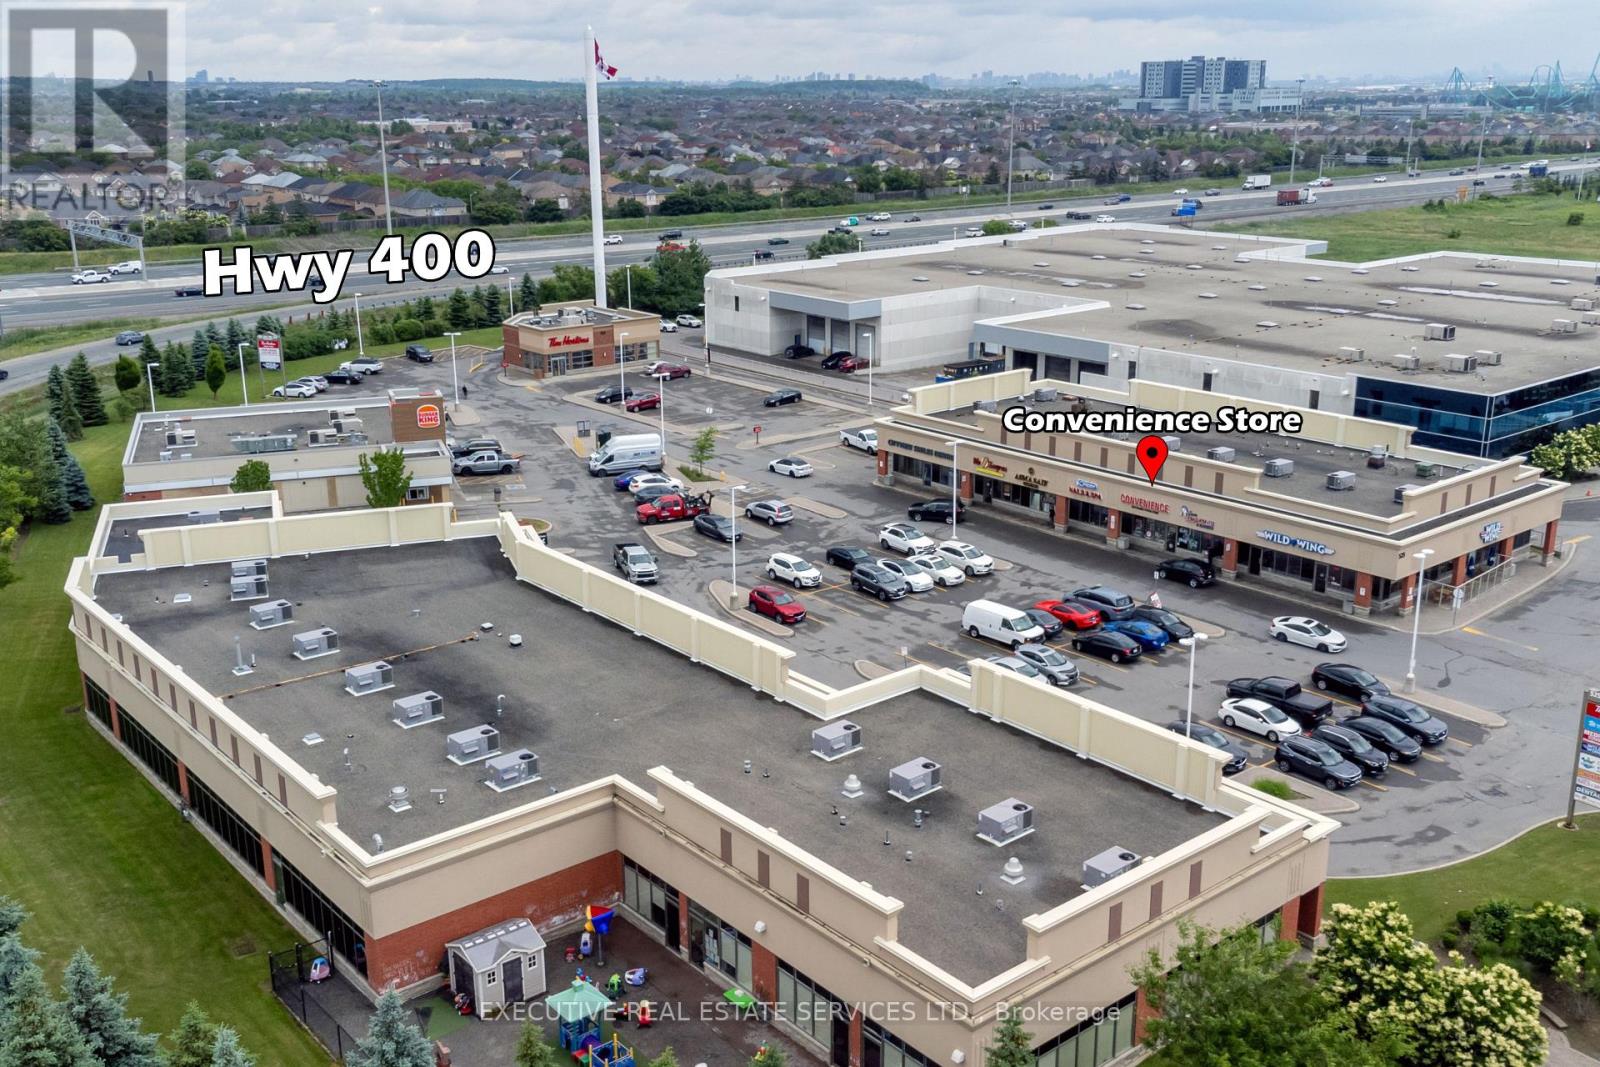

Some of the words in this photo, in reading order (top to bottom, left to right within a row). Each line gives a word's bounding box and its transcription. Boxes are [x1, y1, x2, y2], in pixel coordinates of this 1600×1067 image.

[418, 416, 439, 424] KING
[1120, 494, 1169, 513] CONVENIENCE
[1264, 530, 1290, 545] WILD
[1296, 539, 1325, 554] WING
